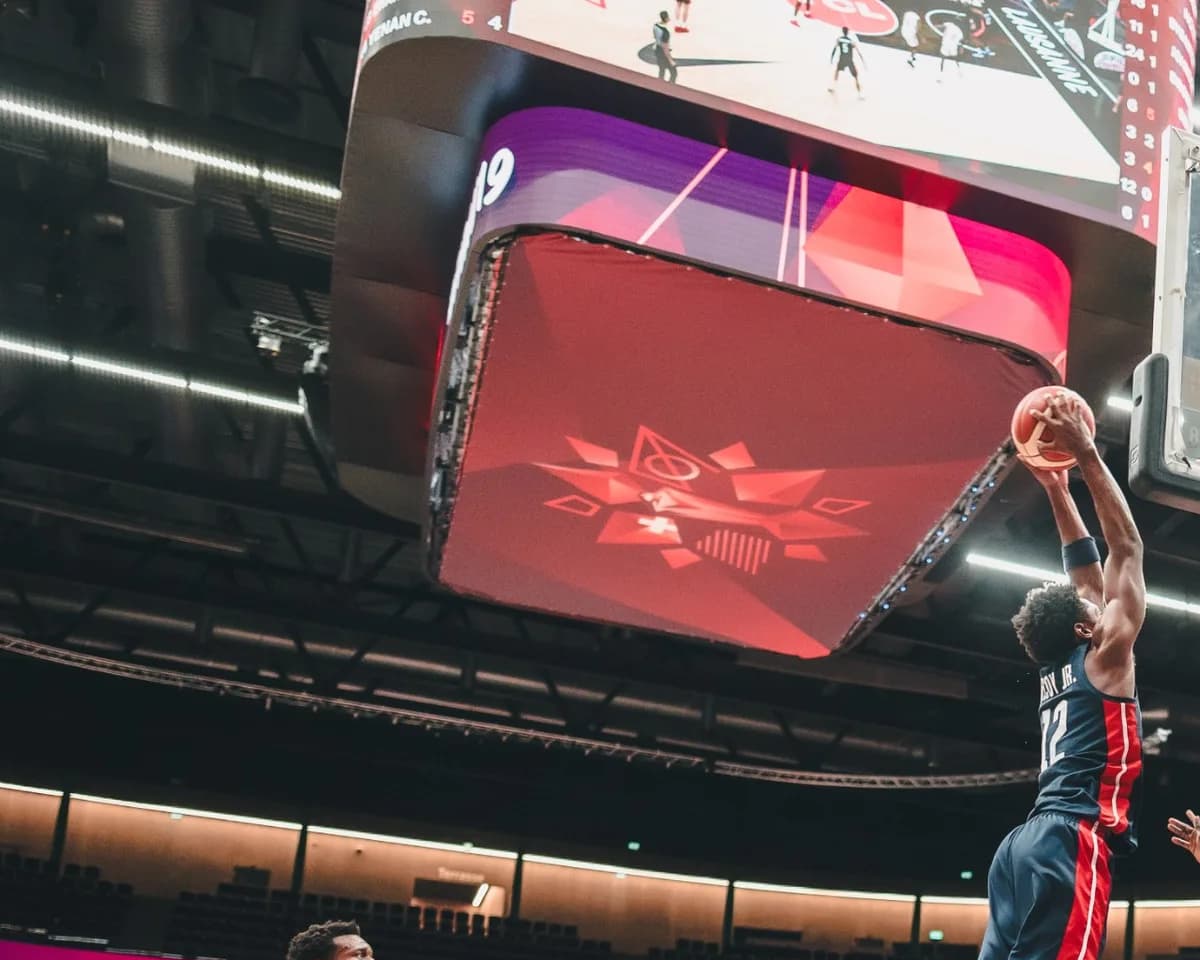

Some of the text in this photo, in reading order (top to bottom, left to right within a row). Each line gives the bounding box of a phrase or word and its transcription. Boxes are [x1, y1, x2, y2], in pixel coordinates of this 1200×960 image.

[461, 9, 475, 25] 5
[487, 15, 503, 32] 4
[1120, 177, 1137, 196] 12
[1061, 663, 1077, 691] JR.
